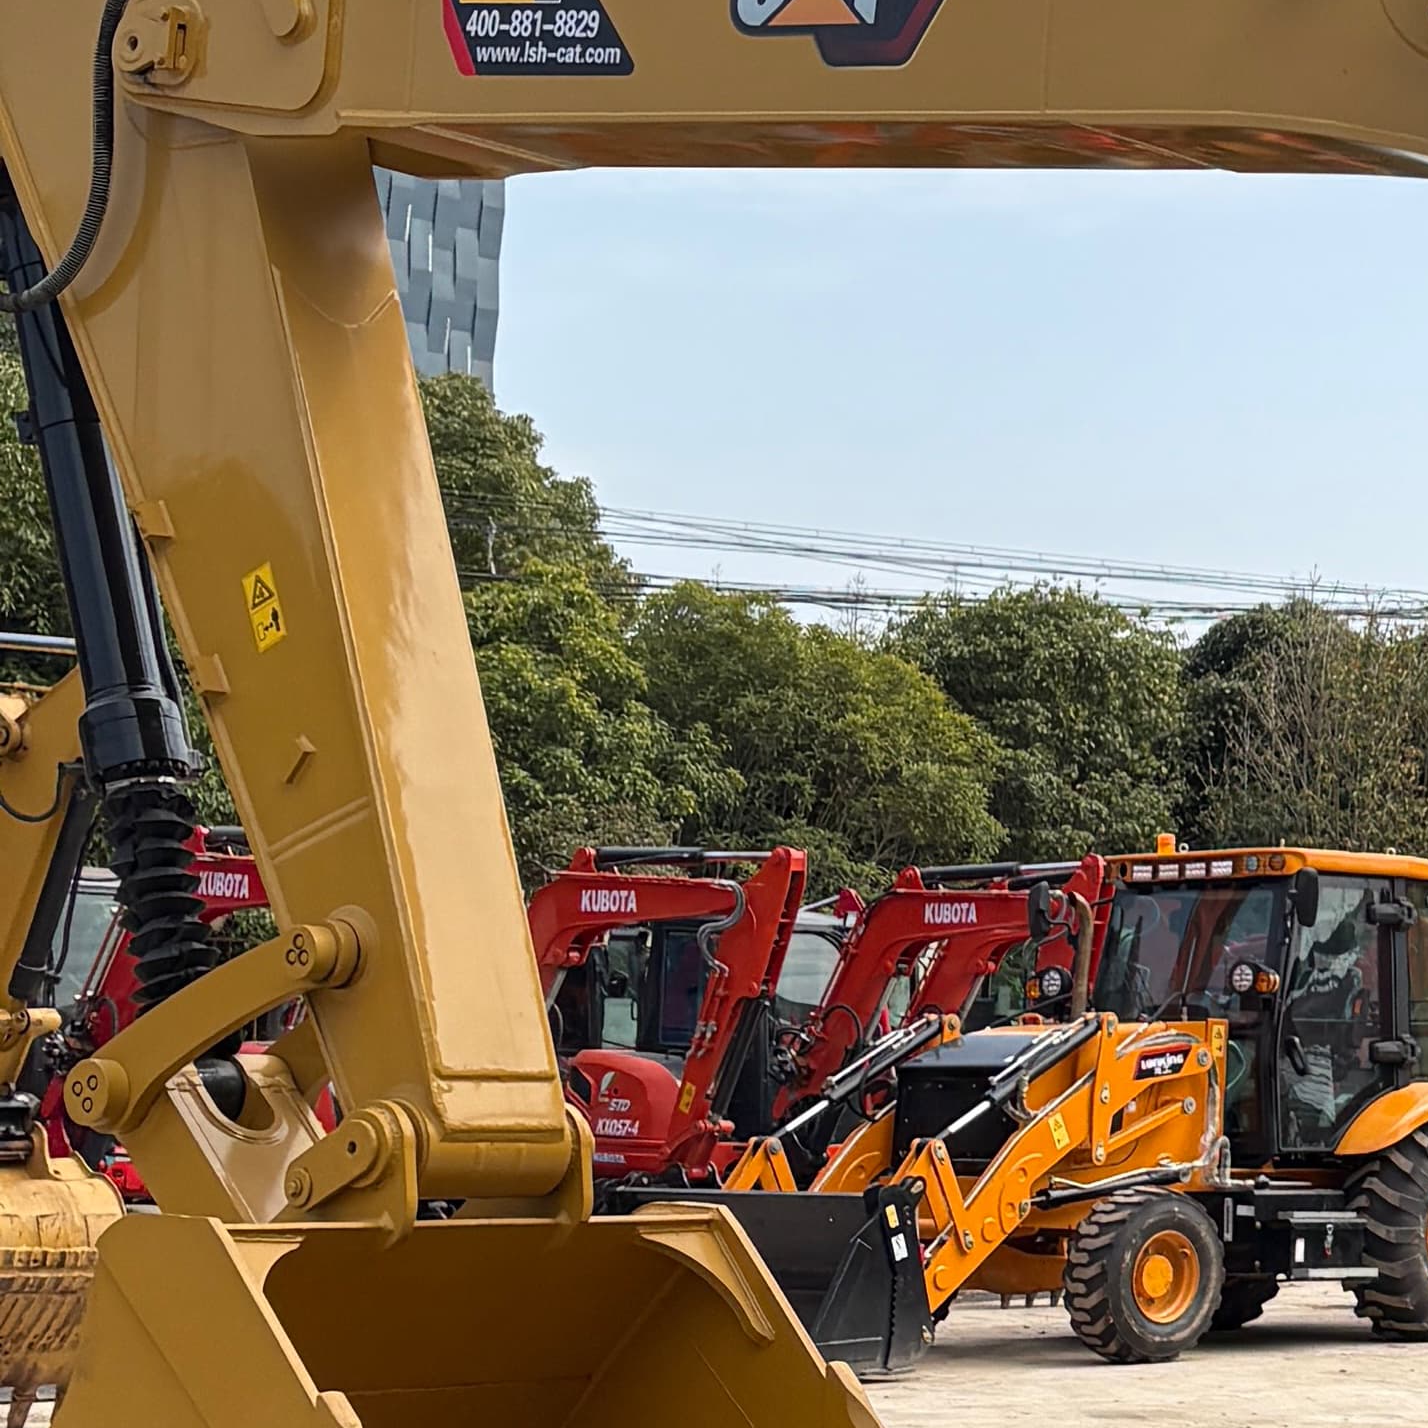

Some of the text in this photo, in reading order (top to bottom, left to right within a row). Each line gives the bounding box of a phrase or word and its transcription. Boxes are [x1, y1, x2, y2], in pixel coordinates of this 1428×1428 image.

[465, 9, 600, 38] 400-881-8829
[476, 41, 621, 64] www.lsh-cat.com
[198, 871, 249, 900] KUBOTA
[581, 889, 637, 913] KUBOTA
[924, 902, 978, 924] KUBOTA
